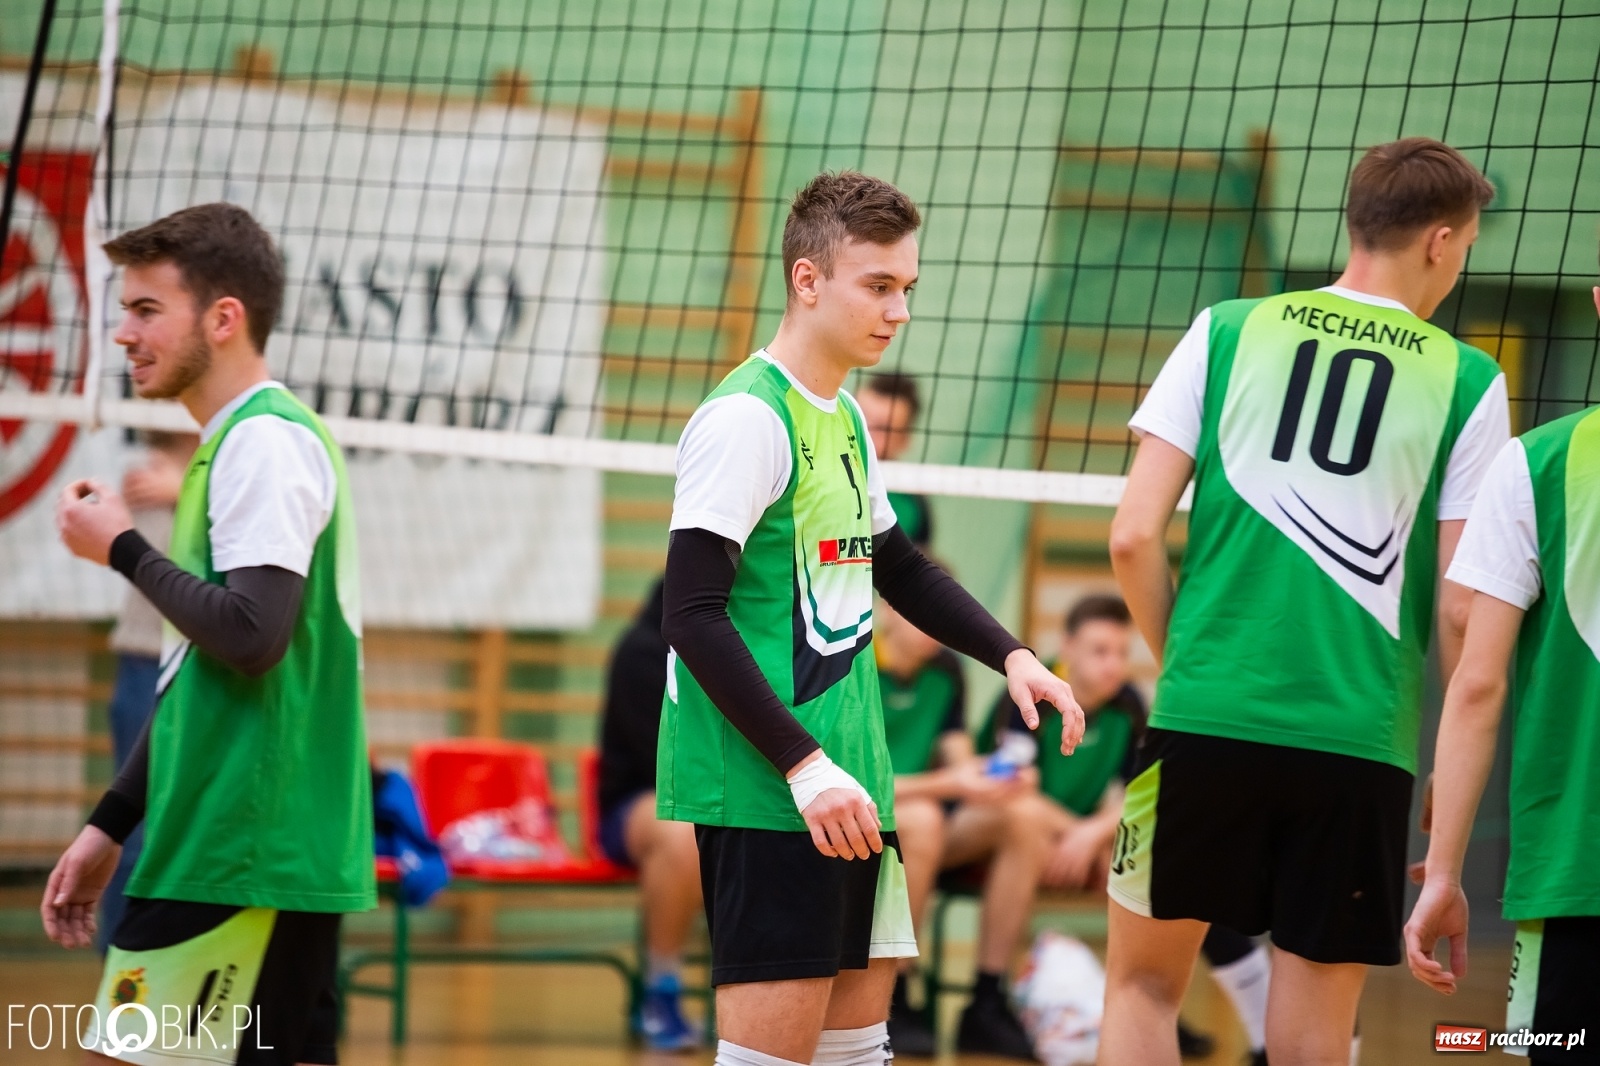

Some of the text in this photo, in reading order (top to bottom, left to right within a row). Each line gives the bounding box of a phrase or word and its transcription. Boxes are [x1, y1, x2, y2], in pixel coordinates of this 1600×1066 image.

[298, 257, 524, 342] ASTO
[1281, 303, 1429, 355] MECHANIK
[1270, 338, 1395, 477] 10
